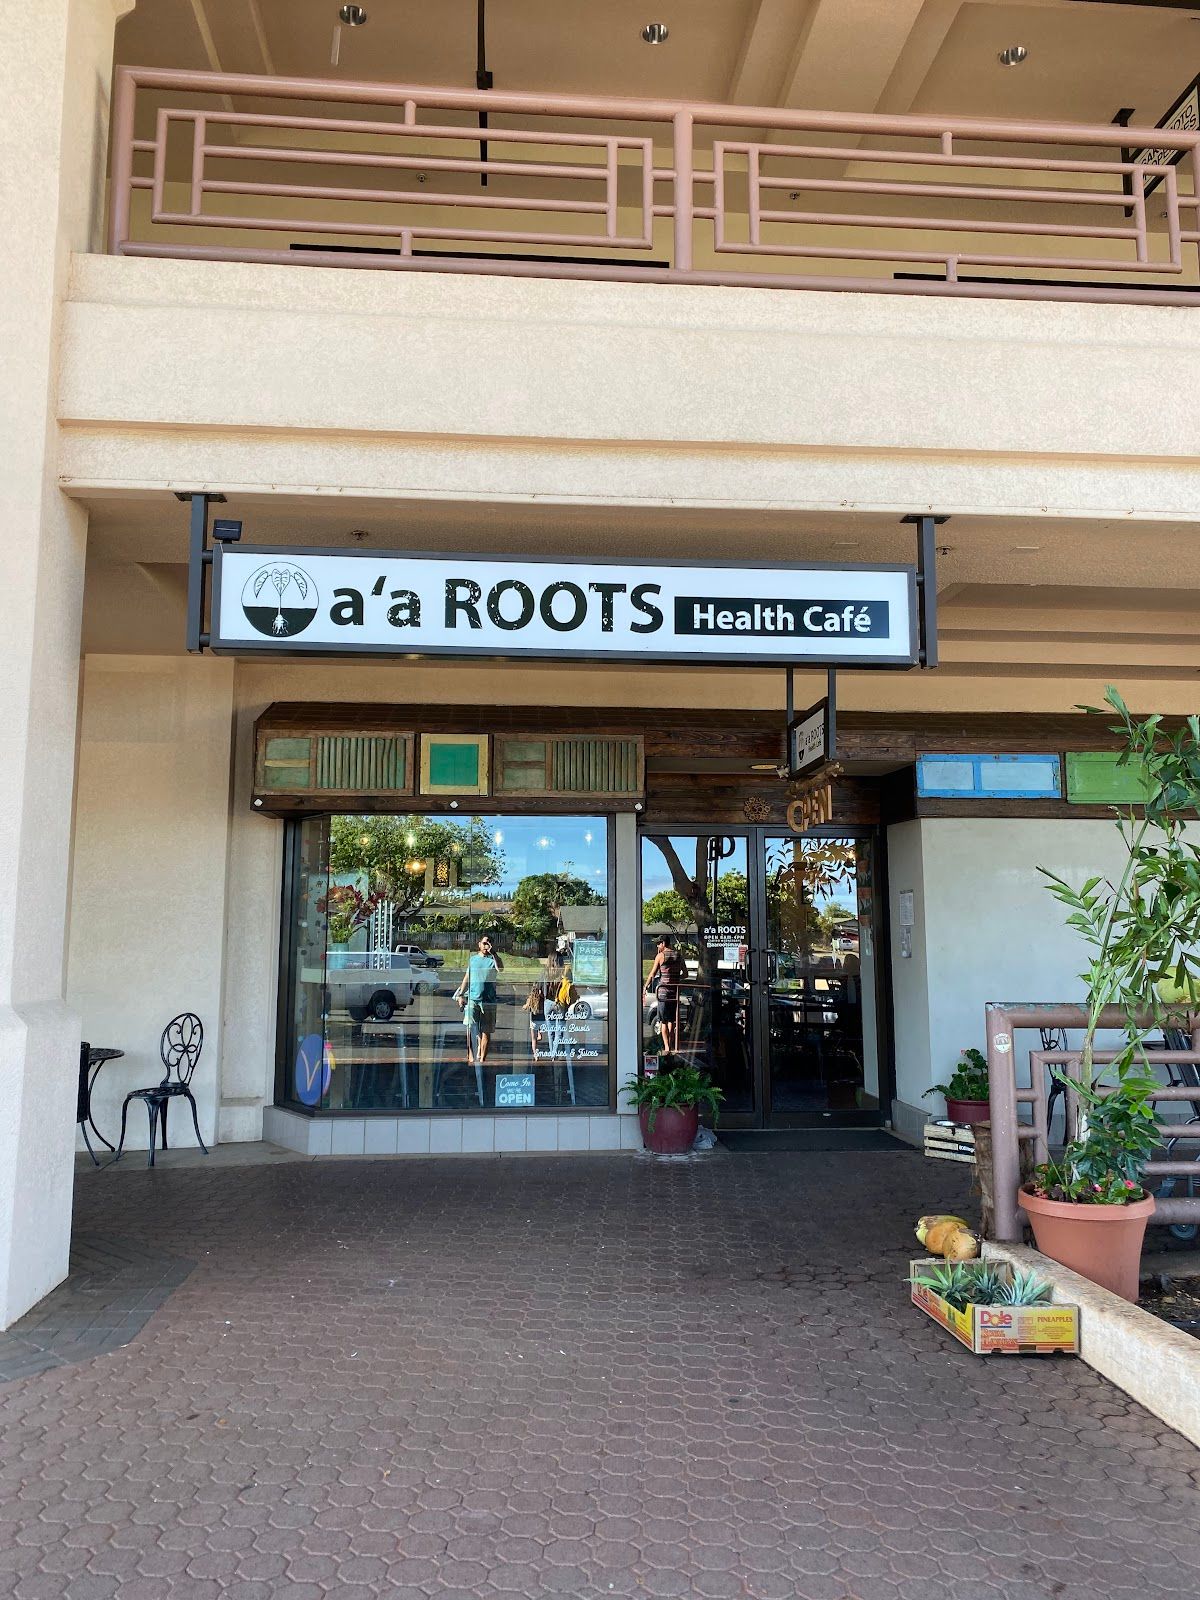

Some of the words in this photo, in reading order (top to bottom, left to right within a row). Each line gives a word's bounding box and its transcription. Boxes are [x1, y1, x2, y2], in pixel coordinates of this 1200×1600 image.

[329, 575, 422, 628] a'a
[444, 577, 664, 635] ROOTS
[693, 603, 795, 632] Health
[803, 605, 871, 634] Café
[718, 925, 747, 934] ROOTS
[569, 1048, 576, 1058] &
[577, 1048, 599, 1060] Juices
[500, 1077, 519, 1089] Come
[499, 1093, 532, 1104] OPEN
[980, 1310, 1013, 1327] Dole
